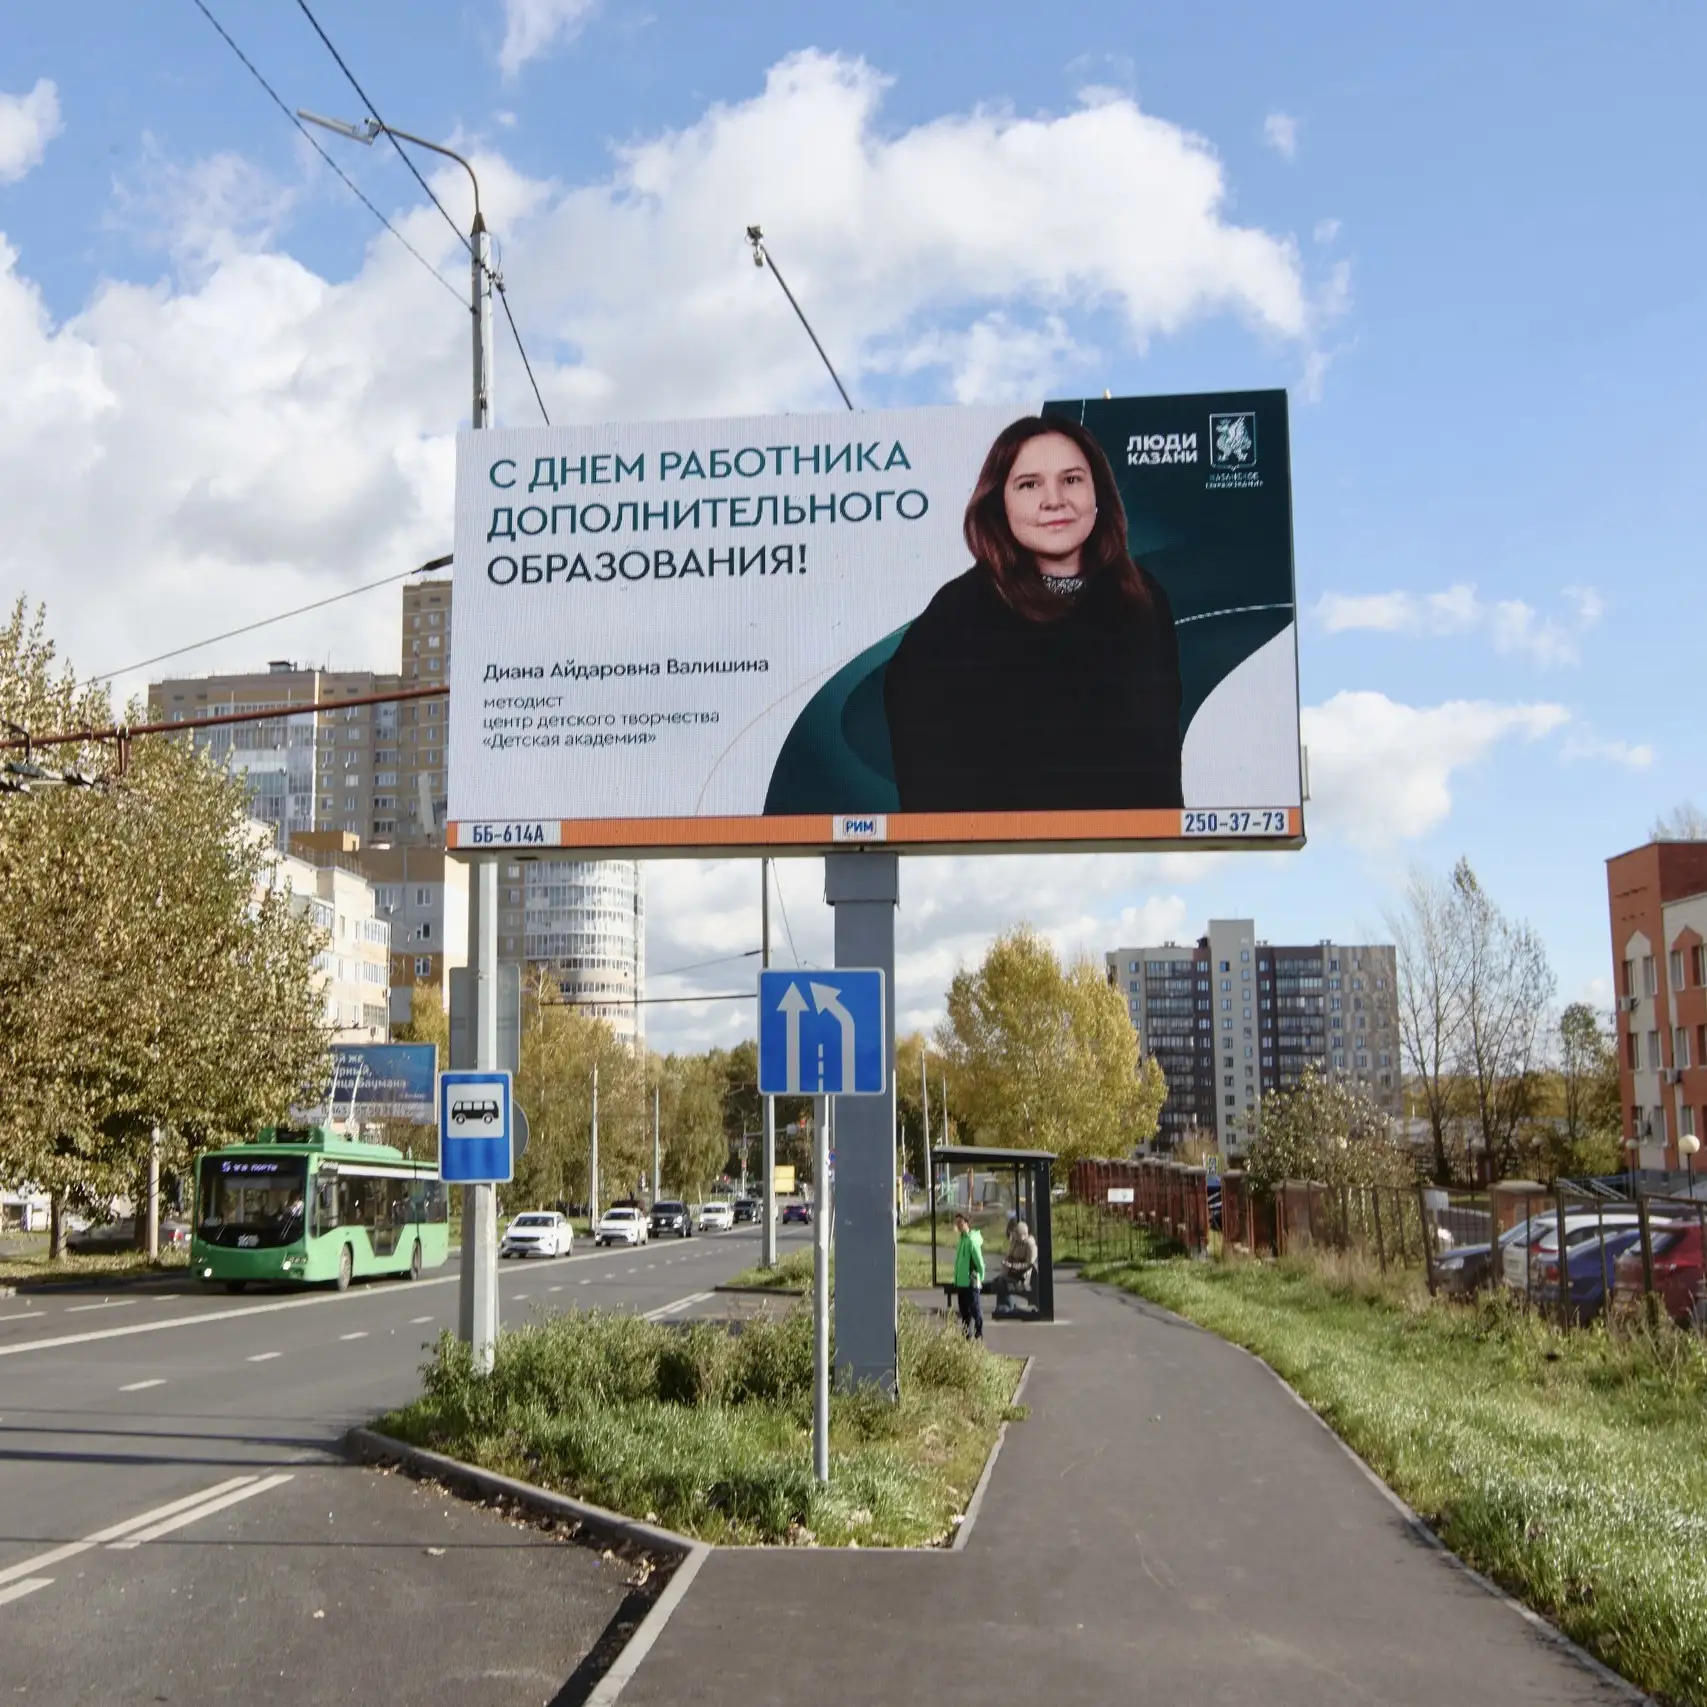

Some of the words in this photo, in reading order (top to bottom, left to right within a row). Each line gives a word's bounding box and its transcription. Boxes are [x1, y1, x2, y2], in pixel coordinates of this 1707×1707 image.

[1126, 432, 1197, 452] ЛЮДИ
[489, 458, 517, 489] С
[528, 453, 645, 493] ДНЕМ
[660, 440, 912, 481] РАБОТНИКА
[1127, 450, 1198, 466] КАЗАНИ
[487, 489, 929, 543] ДОПОЛНИТЕЛЬНОГО
[487, 544, 807, 586] ОБРАЗОВАНИЯ!
[483, 664, 545, 682] Диана
[550, 659, 661, 681] Айдаровна
[666, 657, 769, 675] Валишина
[483, 695, 564, 710] методист
[483, 717, 533, 731] центр
[536, 713, 616, 729] детского
[622, 711, 720, 727] творчества
[482, 733, 560, 750] «Детская
[564, 731, 657, 748] академия»
[845, 820, 875, 834] РИМ
[1185, 812, 1285, 833] 250-37-73
[472, 824, 544, 843] ББ-614А
